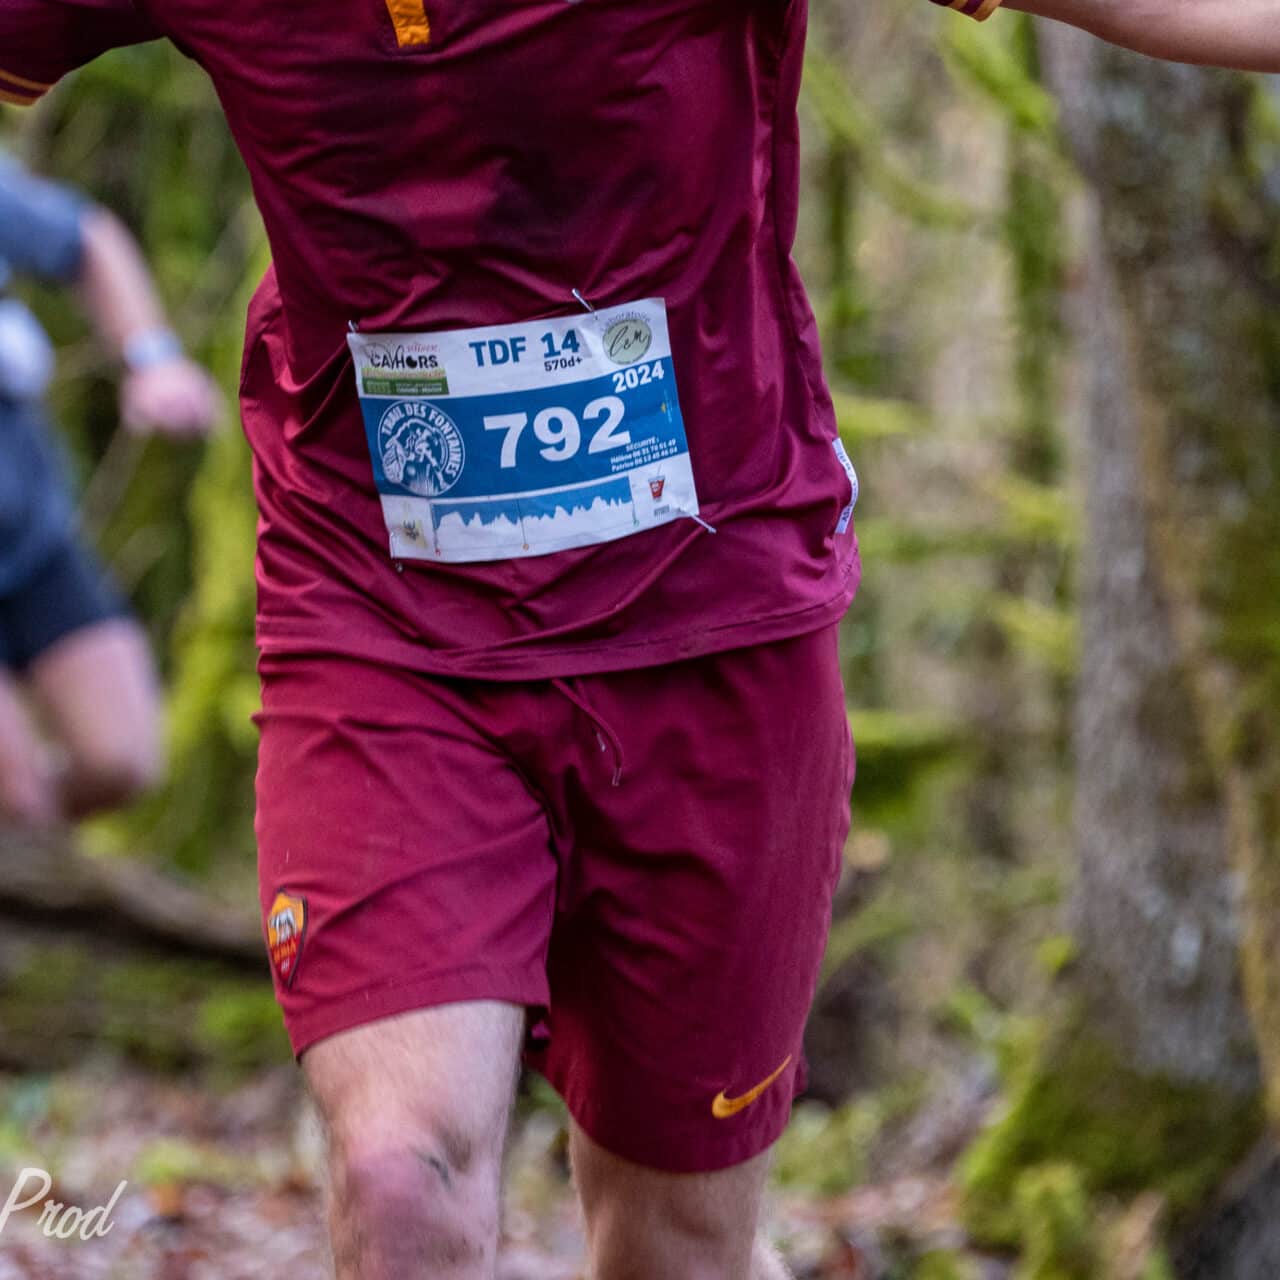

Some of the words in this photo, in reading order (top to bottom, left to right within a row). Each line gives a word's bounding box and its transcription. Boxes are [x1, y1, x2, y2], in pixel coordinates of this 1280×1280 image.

[468, 336, 527, 368] TDF
[540, 328, 580, 359] 14
[544, 356, 583, 372] 570d+
[612, 359, 665, 394] 2024
[404, 403, 427, 418] DES
[483, 395, 631, 469] 792
